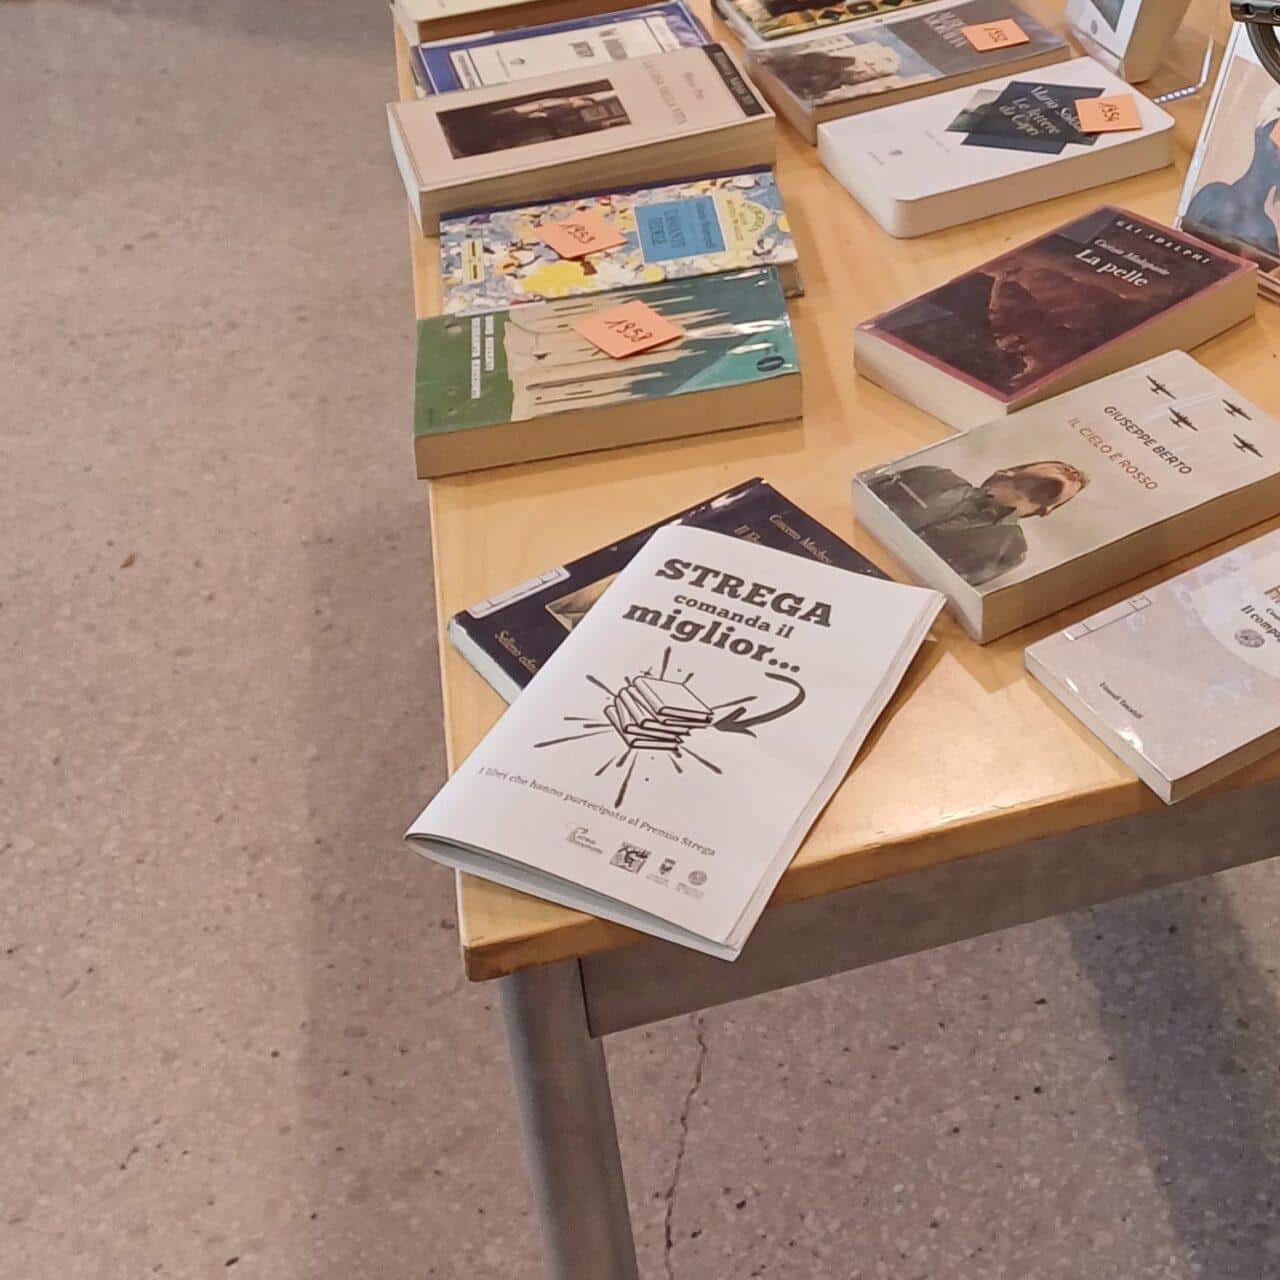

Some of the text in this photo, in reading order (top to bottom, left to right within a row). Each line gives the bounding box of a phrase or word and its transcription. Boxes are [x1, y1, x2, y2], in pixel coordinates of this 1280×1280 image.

[1074, 248, 1149, 288] La pelle
[1103, 405, 1193, 475] GIUSEPPE BERTO
[1119, 459, 1159, 491] ROSSO
[655, 558, 832, 628] STREGA
[673, 594, 795, 639] comanda il
[622, 604, 801, 673] miglior...
[508, 775, 529, 785] che
[529, 779, 564, 797] hanno
[563, 793, 627, 822] partecipato
[627, 817, 640, 826] al
[639, 821, 679, 842] Premio
[680, 837, 716, 857] Strega
